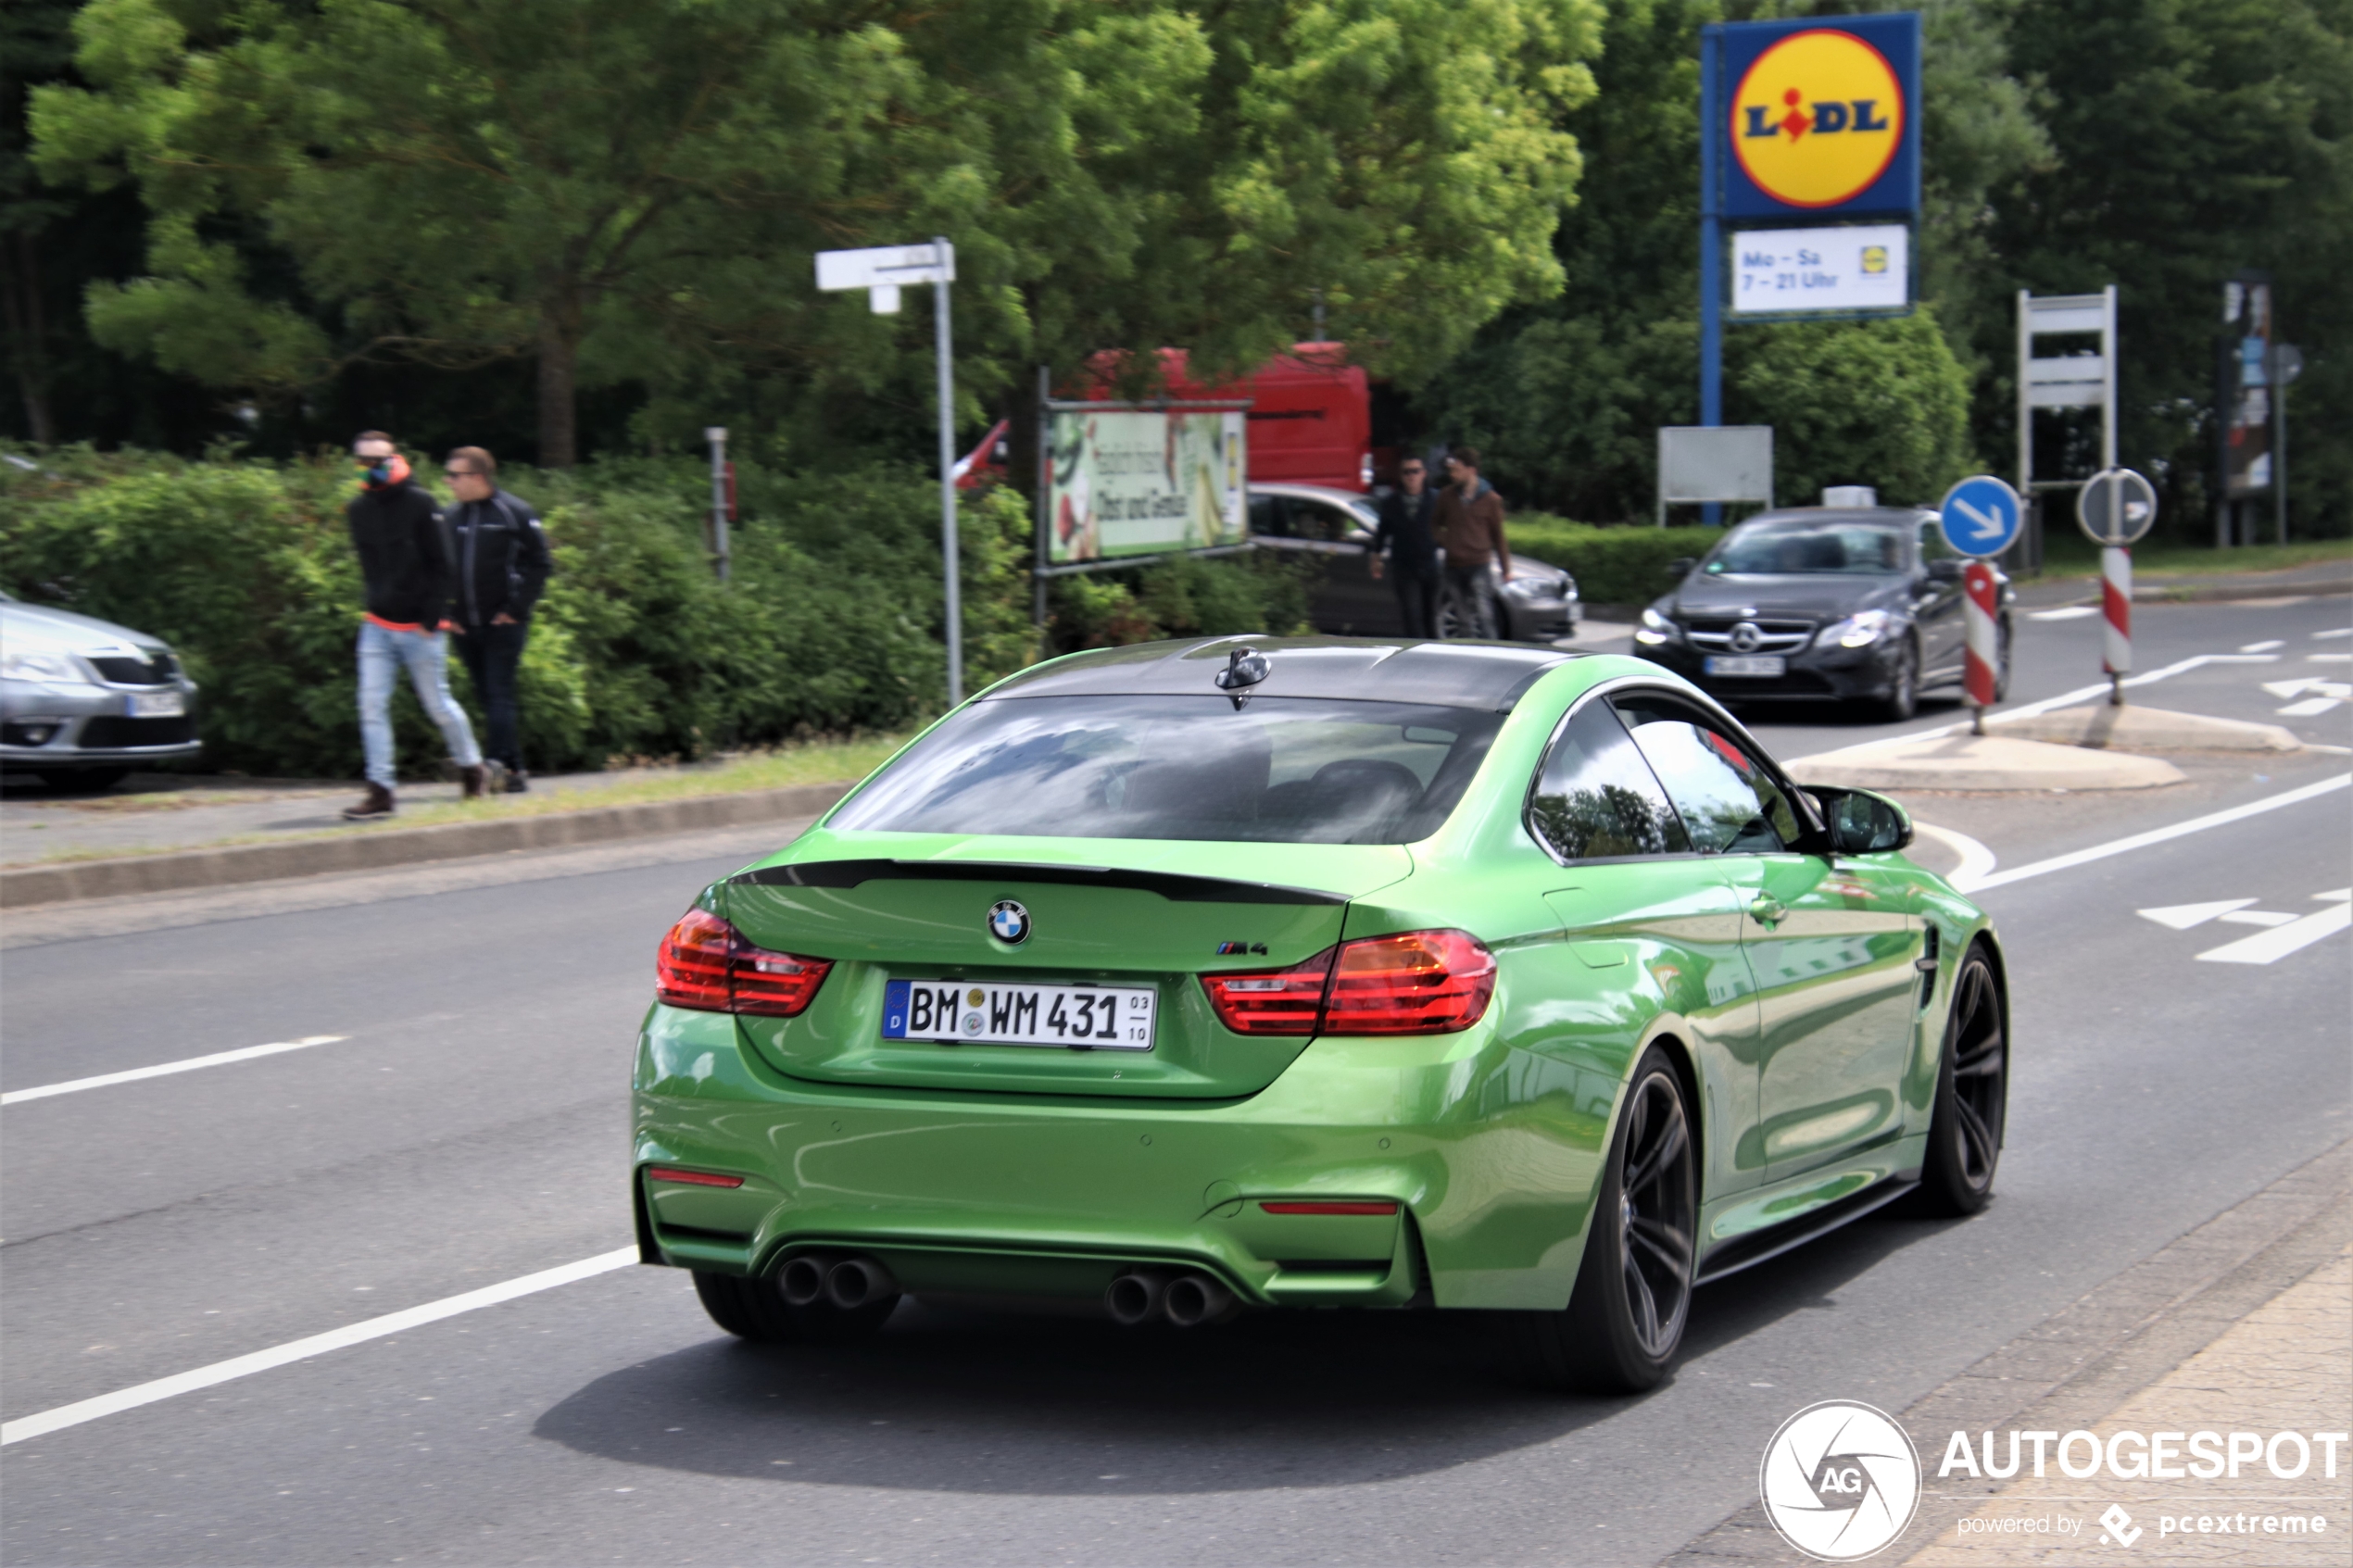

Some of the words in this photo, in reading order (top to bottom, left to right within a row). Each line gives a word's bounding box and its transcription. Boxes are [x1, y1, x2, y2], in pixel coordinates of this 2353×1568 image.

[1743, 250, 1774, 267] Mo
[1797, 249, 1820, 265] Sa
[1743, 273, 1754, 290] 7
[1777, 273, 1795, 289] 21
[1802, 271, 1838, 288] Uhr
[1130, 997, 1149, 1010] 03
[910, 987, 960, 1032] BM
[990, 990, 1038, 1035] WM
[1048, 993, 1117, 1039] 431
[889, 1015, 900, 1029] D
[1129, 1027, 1146, 1040] 10
